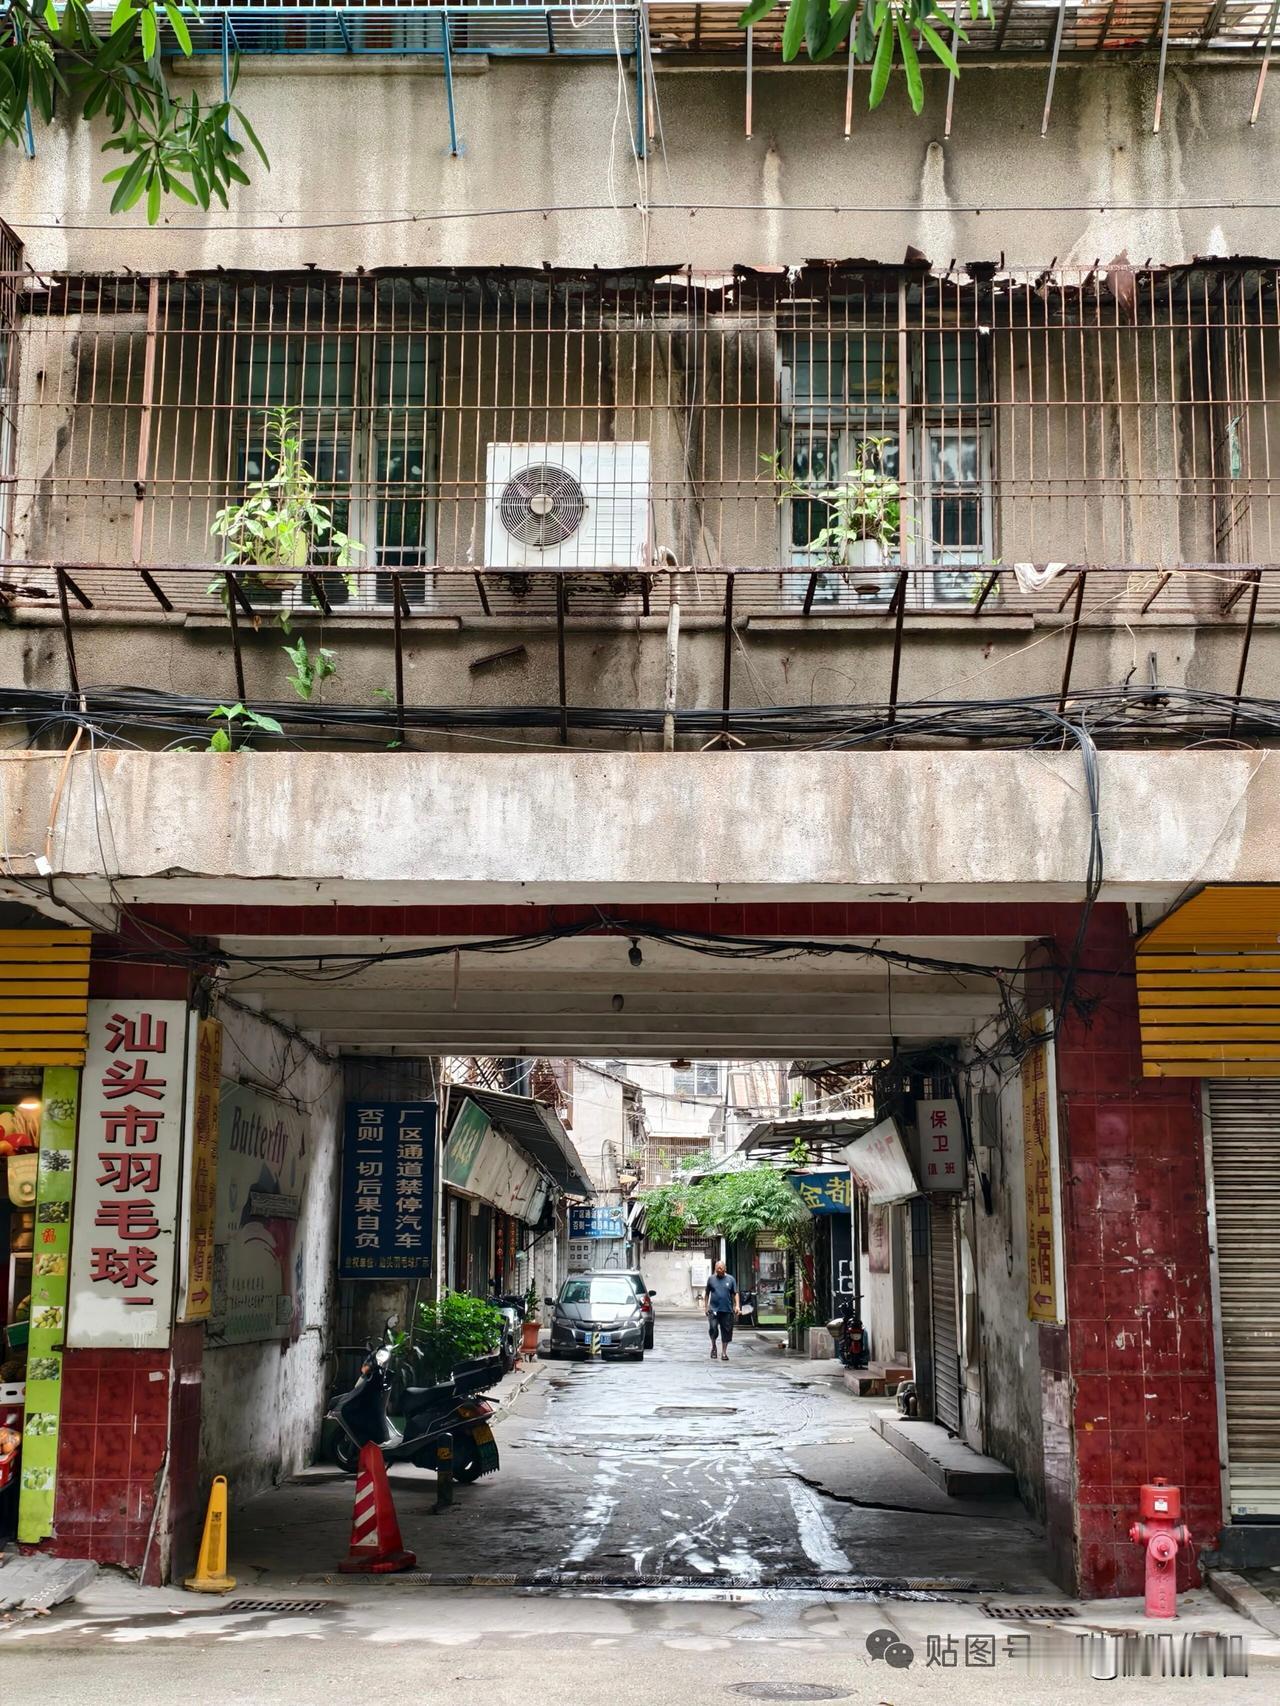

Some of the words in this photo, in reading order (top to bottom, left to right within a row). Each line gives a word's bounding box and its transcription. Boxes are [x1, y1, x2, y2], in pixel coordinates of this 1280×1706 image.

[89, 1012, 167, 1306] 汕头市羽毛球
[229, 1105, 289, 1177] Butterfly
[354, 1109, 385, 1249] 否则一切后果自负
[394, 1110, 424, 1249] 厂区通道禁停汽车
[928, 1162, 955, 1175] 值班
[930, 1110, 949, 1152] 保卫
